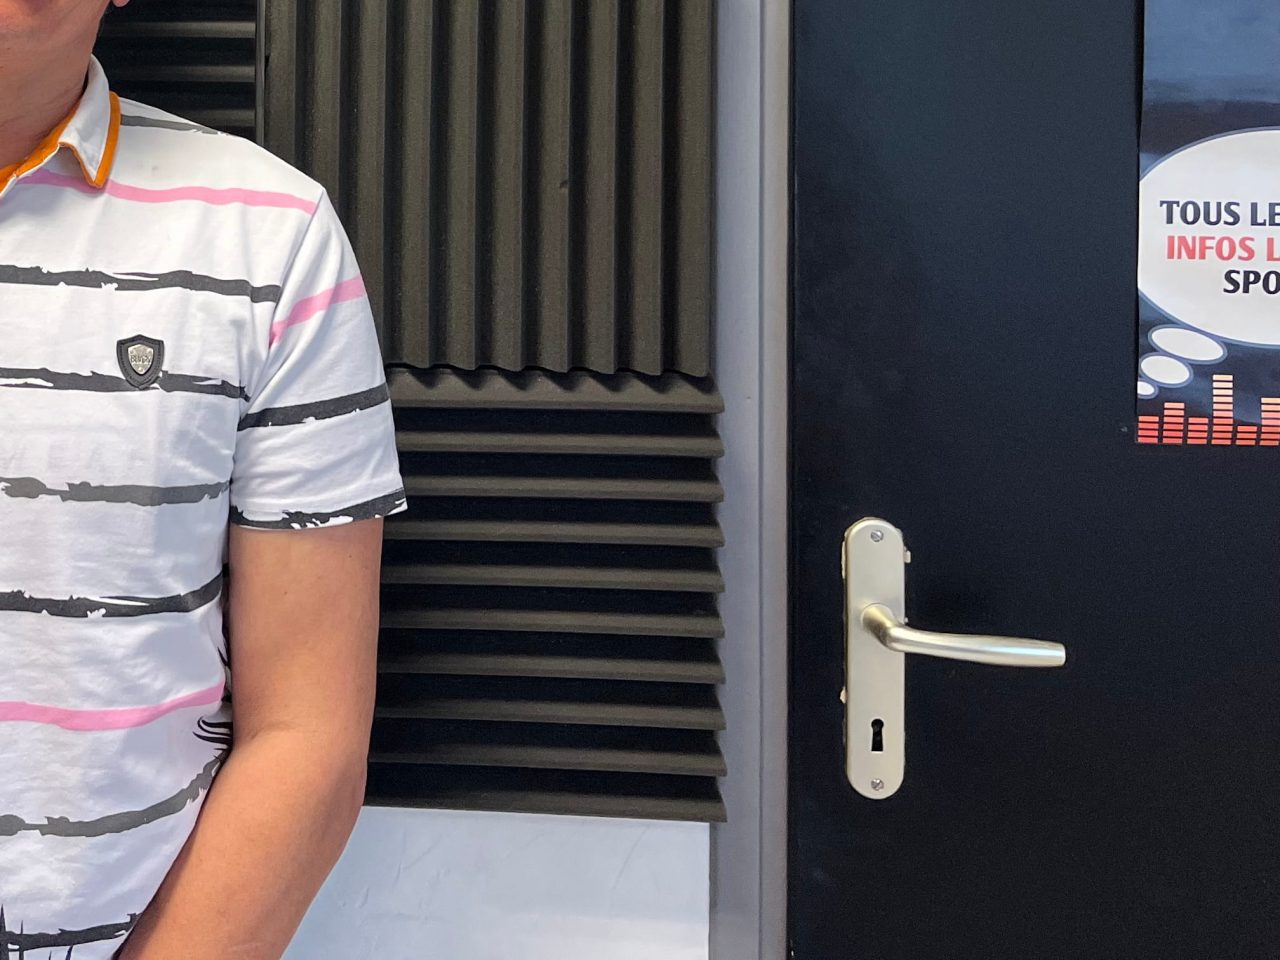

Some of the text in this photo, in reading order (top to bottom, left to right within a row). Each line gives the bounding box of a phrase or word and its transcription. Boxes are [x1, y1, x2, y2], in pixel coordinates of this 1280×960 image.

[1160, 200, 1280, 227] TOUS LE
[1167, 235, 1255, 262] INFOS
[1223, 269, 1280, 295] SPO
